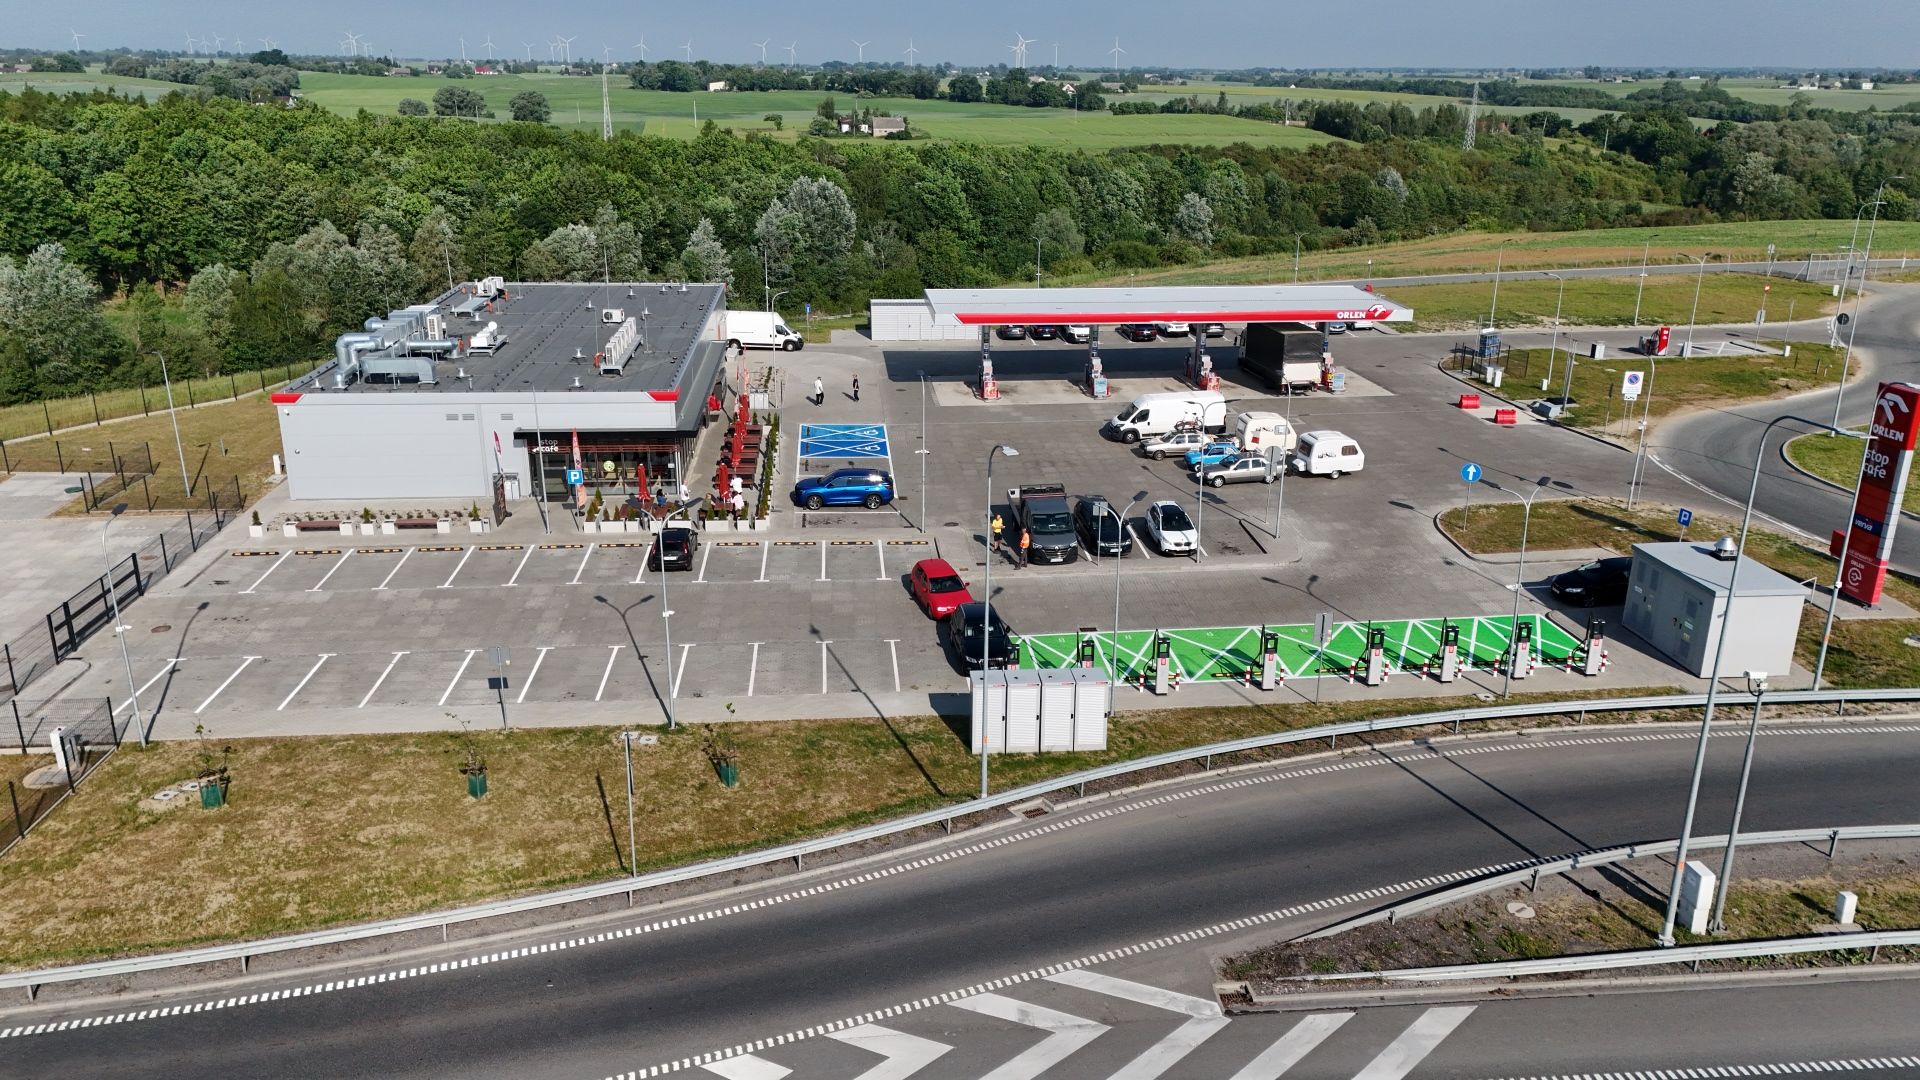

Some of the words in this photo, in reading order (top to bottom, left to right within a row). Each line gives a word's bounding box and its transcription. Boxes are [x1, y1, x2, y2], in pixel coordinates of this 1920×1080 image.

[1336, 311, 1366, 319] ORLEN
[1872, 423, 1905, 442] ORLEN
[1865, 449, 1889, 467] stop
[1863, 462, 1886, 478] cafe
[571, 471, 580, 482] P
[1681, 511, 1689, 522] P
[1855, 519, 1873, 531] verva
